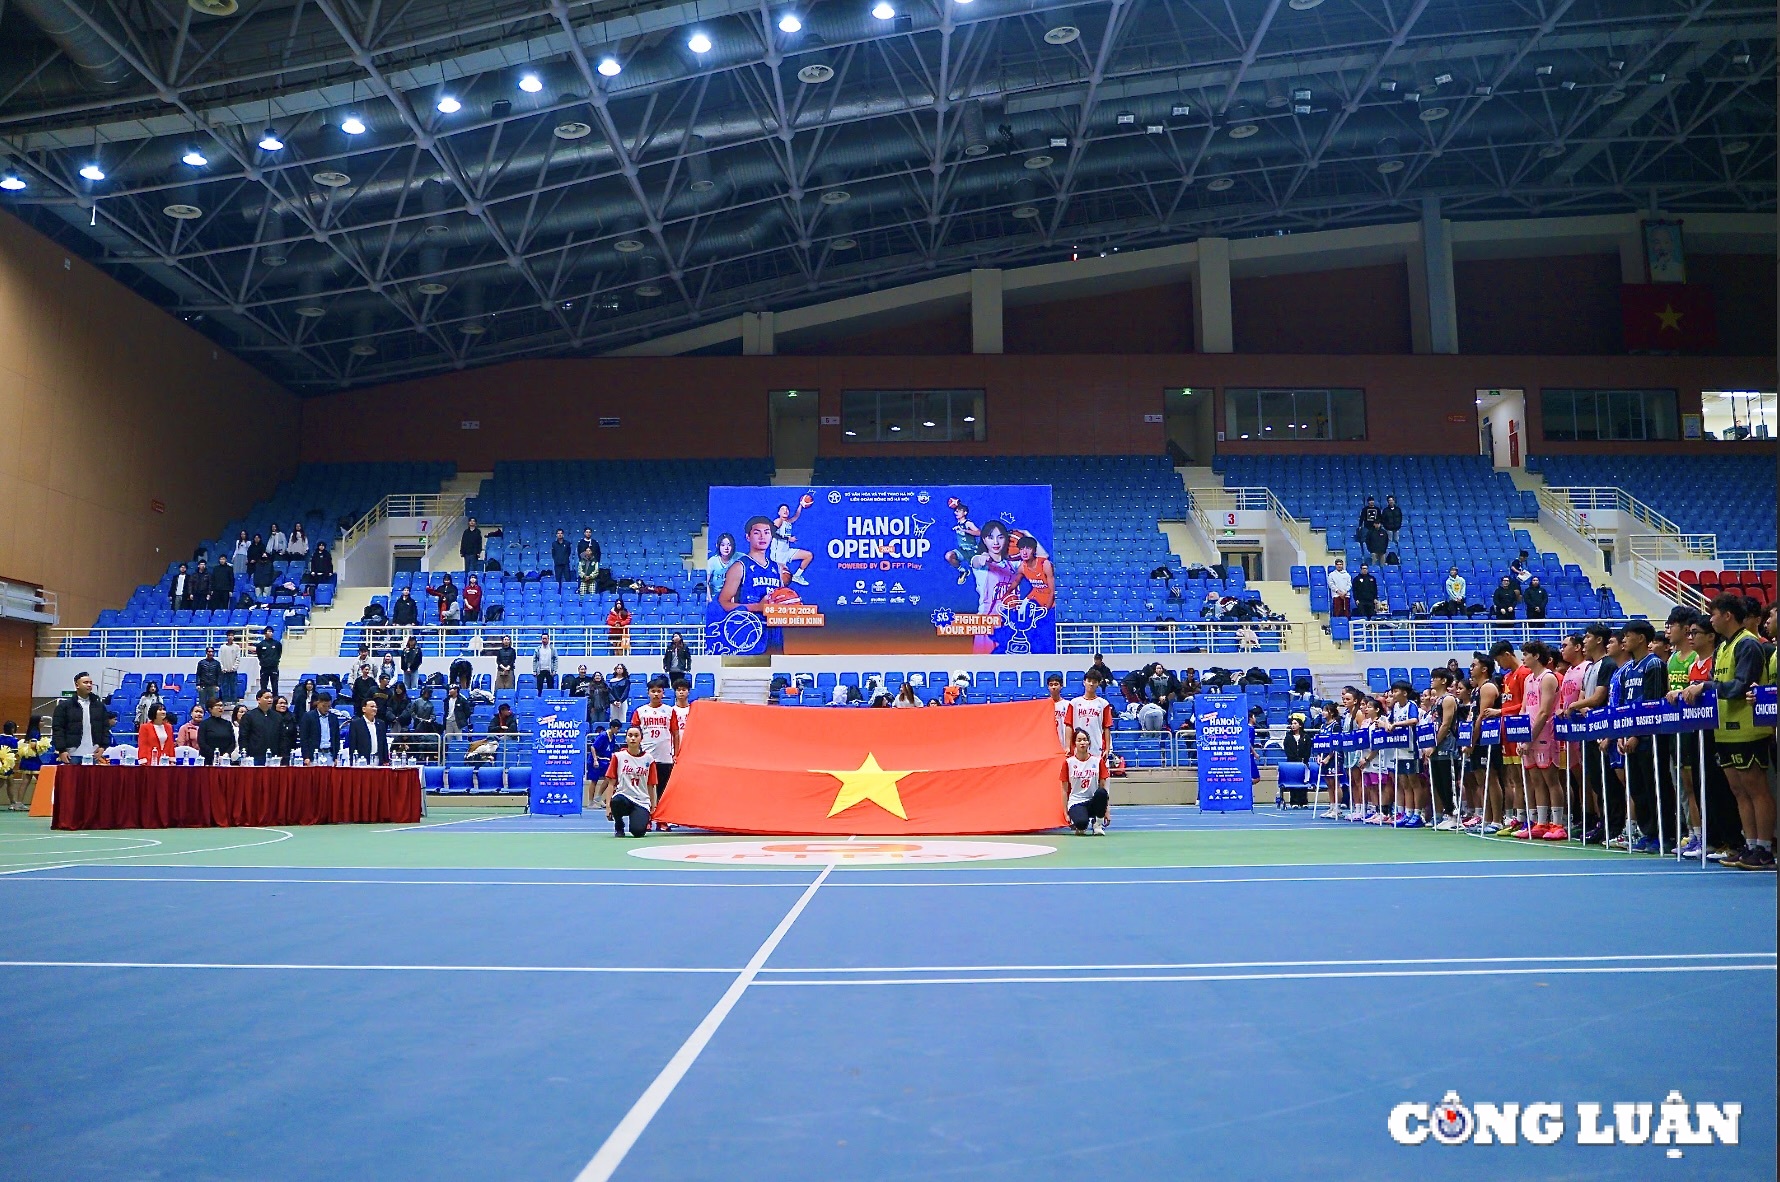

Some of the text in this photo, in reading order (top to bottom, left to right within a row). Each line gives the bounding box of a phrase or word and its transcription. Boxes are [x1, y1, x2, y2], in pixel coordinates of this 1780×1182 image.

[1227, 513, 1235, 525] 3
[421, 520, 428, 532] 7
[827, 538, 884, 559] OPEN
[888, 538, 931, 559] CUP
[837, 562, 868, 570] POWERED
[907, 562, 922, 570] Play
[768, 617, 787, 625] CUNG
[954, 615, 980, 625] FIGHT
[982, 616, 999, 626] FOR
[939, 625, 992, 635] YOUR PRIDE
[539, 729, 580, 739] OPEN CUP
[650, 729, 661, 739] 19
[1202, 726, 1243, 735] OPEN CUP
